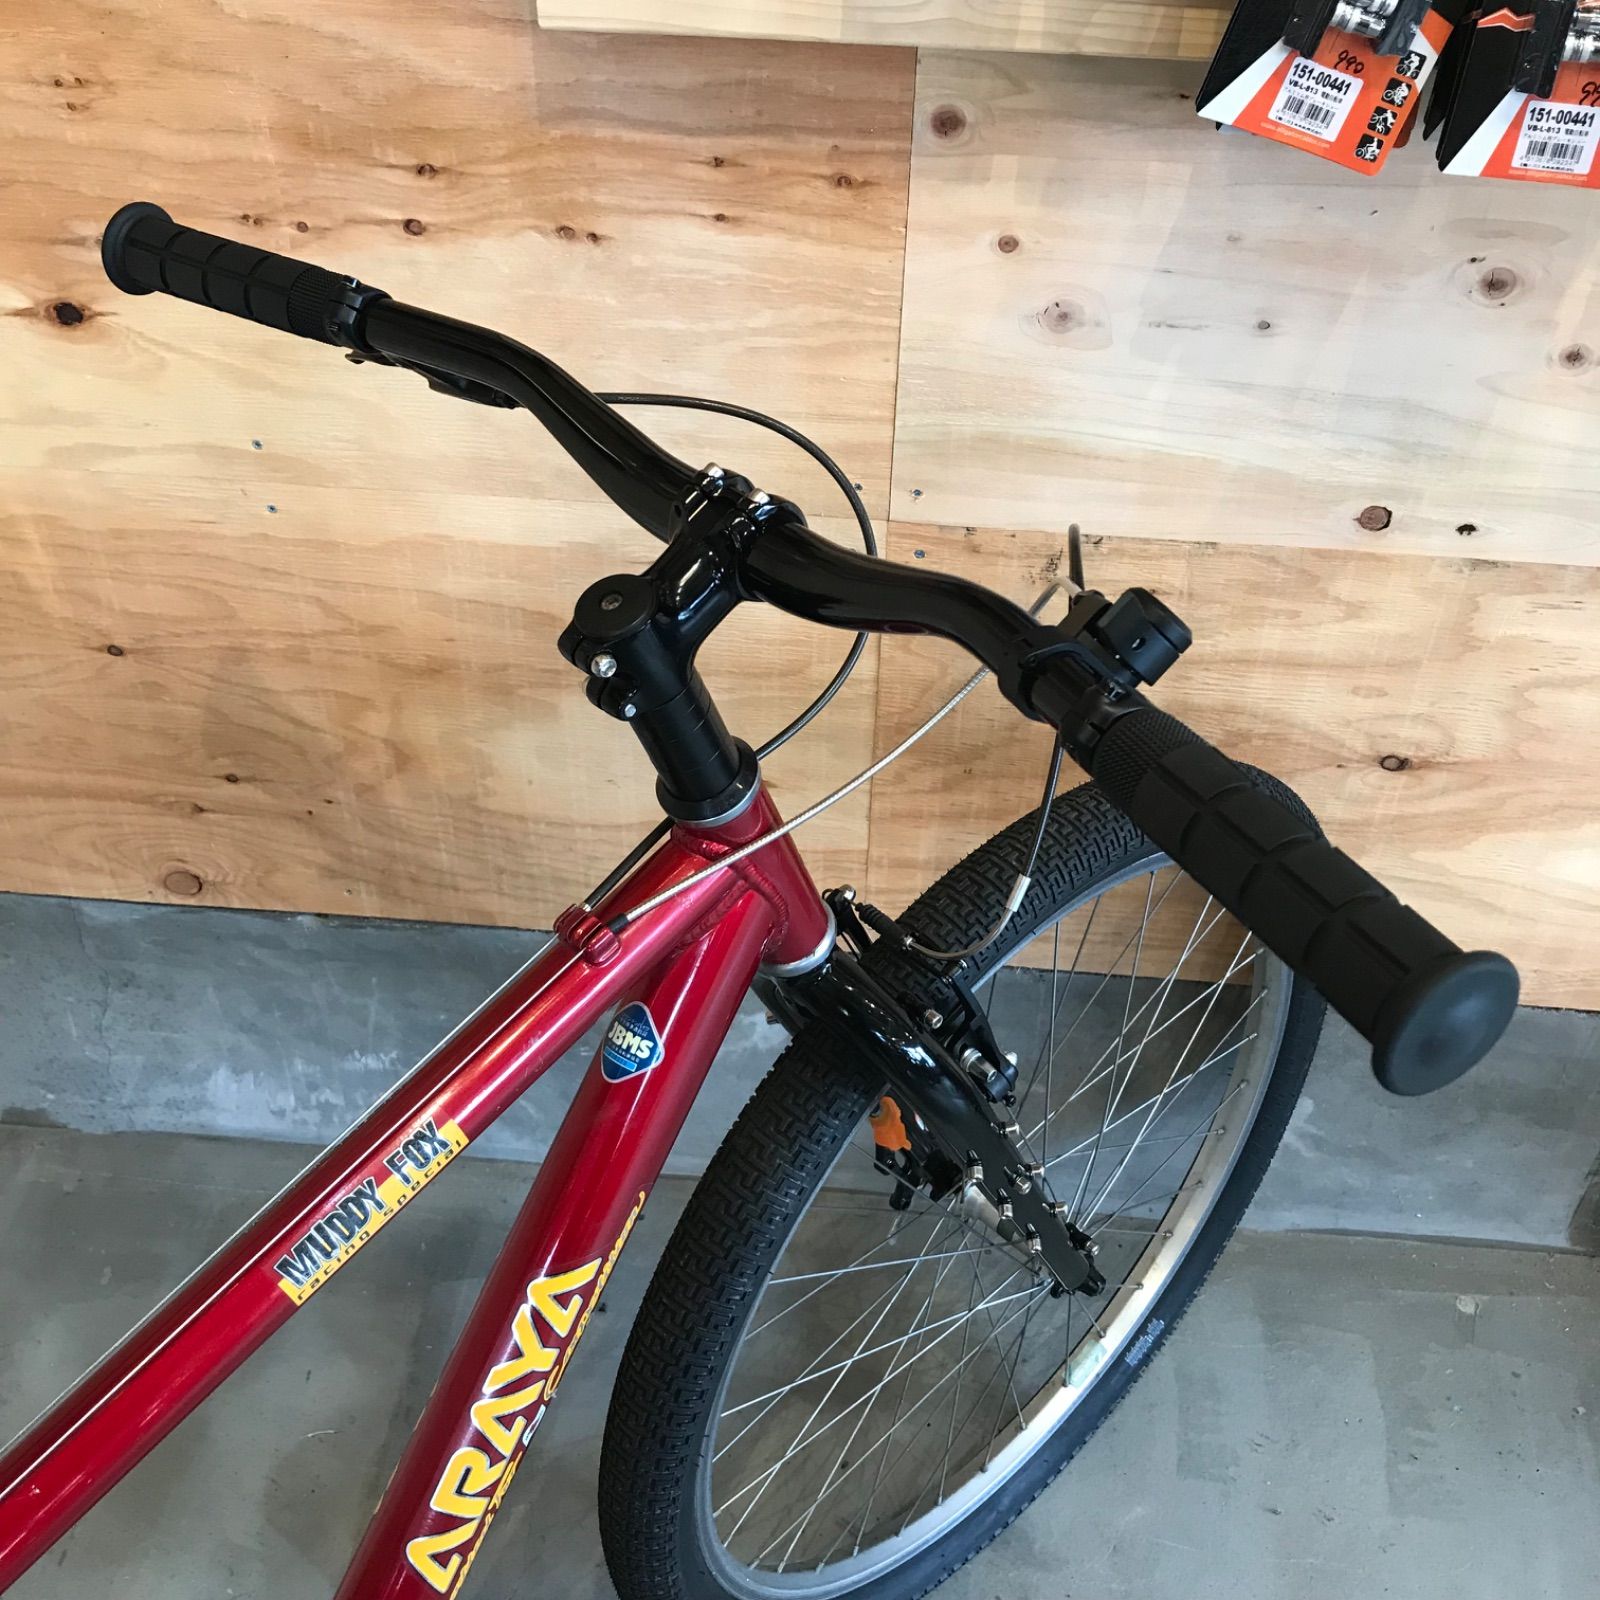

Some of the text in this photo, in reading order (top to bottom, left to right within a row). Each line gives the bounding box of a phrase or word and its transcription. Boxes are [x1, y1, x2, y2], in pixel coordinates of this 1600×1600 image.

[1292, 62, 1352, 96] 151-00441
[1334, 49, 1365, 74] 990
[1529, 106, 1596, 128] 151-00441
[608, 1021, 655, 1059] JBMS
[383, 1139, 462, 1217] special
[273, 1116, 452, 1288] MUDDY FOX
[405, 1257, 602, 1595] ARAYA
